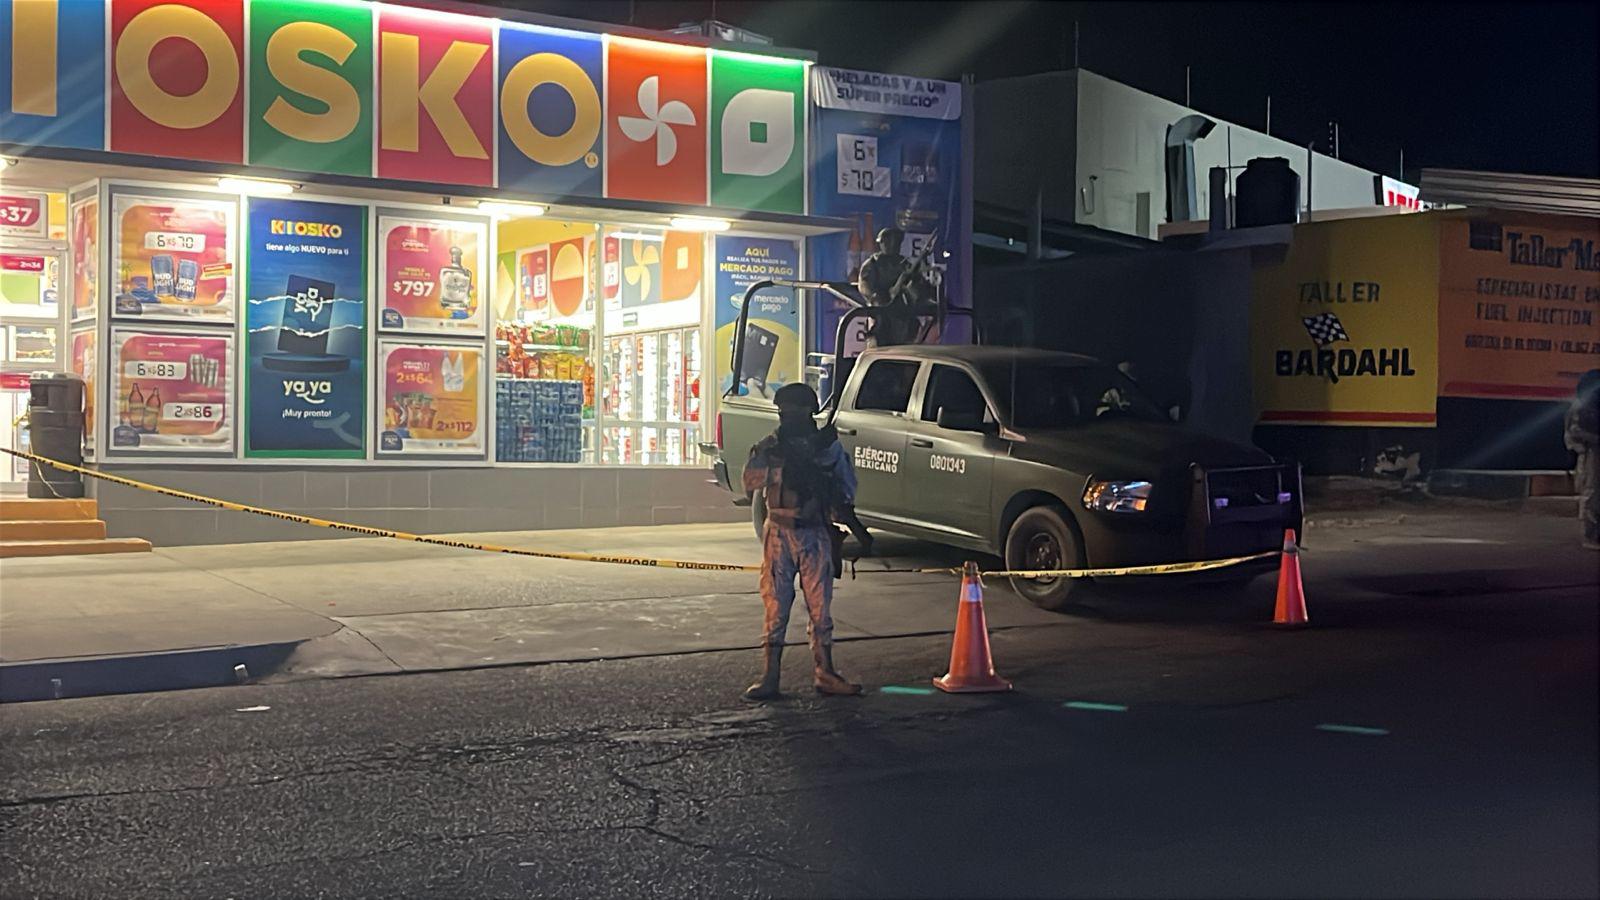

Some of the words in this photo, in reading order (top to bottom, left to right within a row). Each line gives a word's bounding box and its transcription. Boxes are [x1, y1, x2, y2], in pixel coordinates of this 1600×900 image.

[271, 220, 342, 238] KIOSKO
[266, 243, 283, 251] tiene
[285, 244, 300, 254] algo
[301, 245, 326, 254] NUEVO
[327, 247, 342, 255] para
[720, 262, 766, 274] MERCADO
[768, 265, 793, 276] PAGO
[393, 280, 435, 296] $797
[1300, 281, 1380, 304] TALLER
[1476, 277, 1577, 300] ESPECIALISTAS
[753, 294, 789, 304] mercado
[761, 303, 782, 313] pago
[1517, 305, 1592, 326] INJECTION
[1274, 347, 1416, 382] BARDAHL
[282, 408, 301, 419] ¡Muy
[304, 410, 331, 419] pronto!
[854, 446, 899, 464] EJÉRCITO
[855, 458, 898, 473] MEXICANO
[930, 454, 966, 474] 0801343
